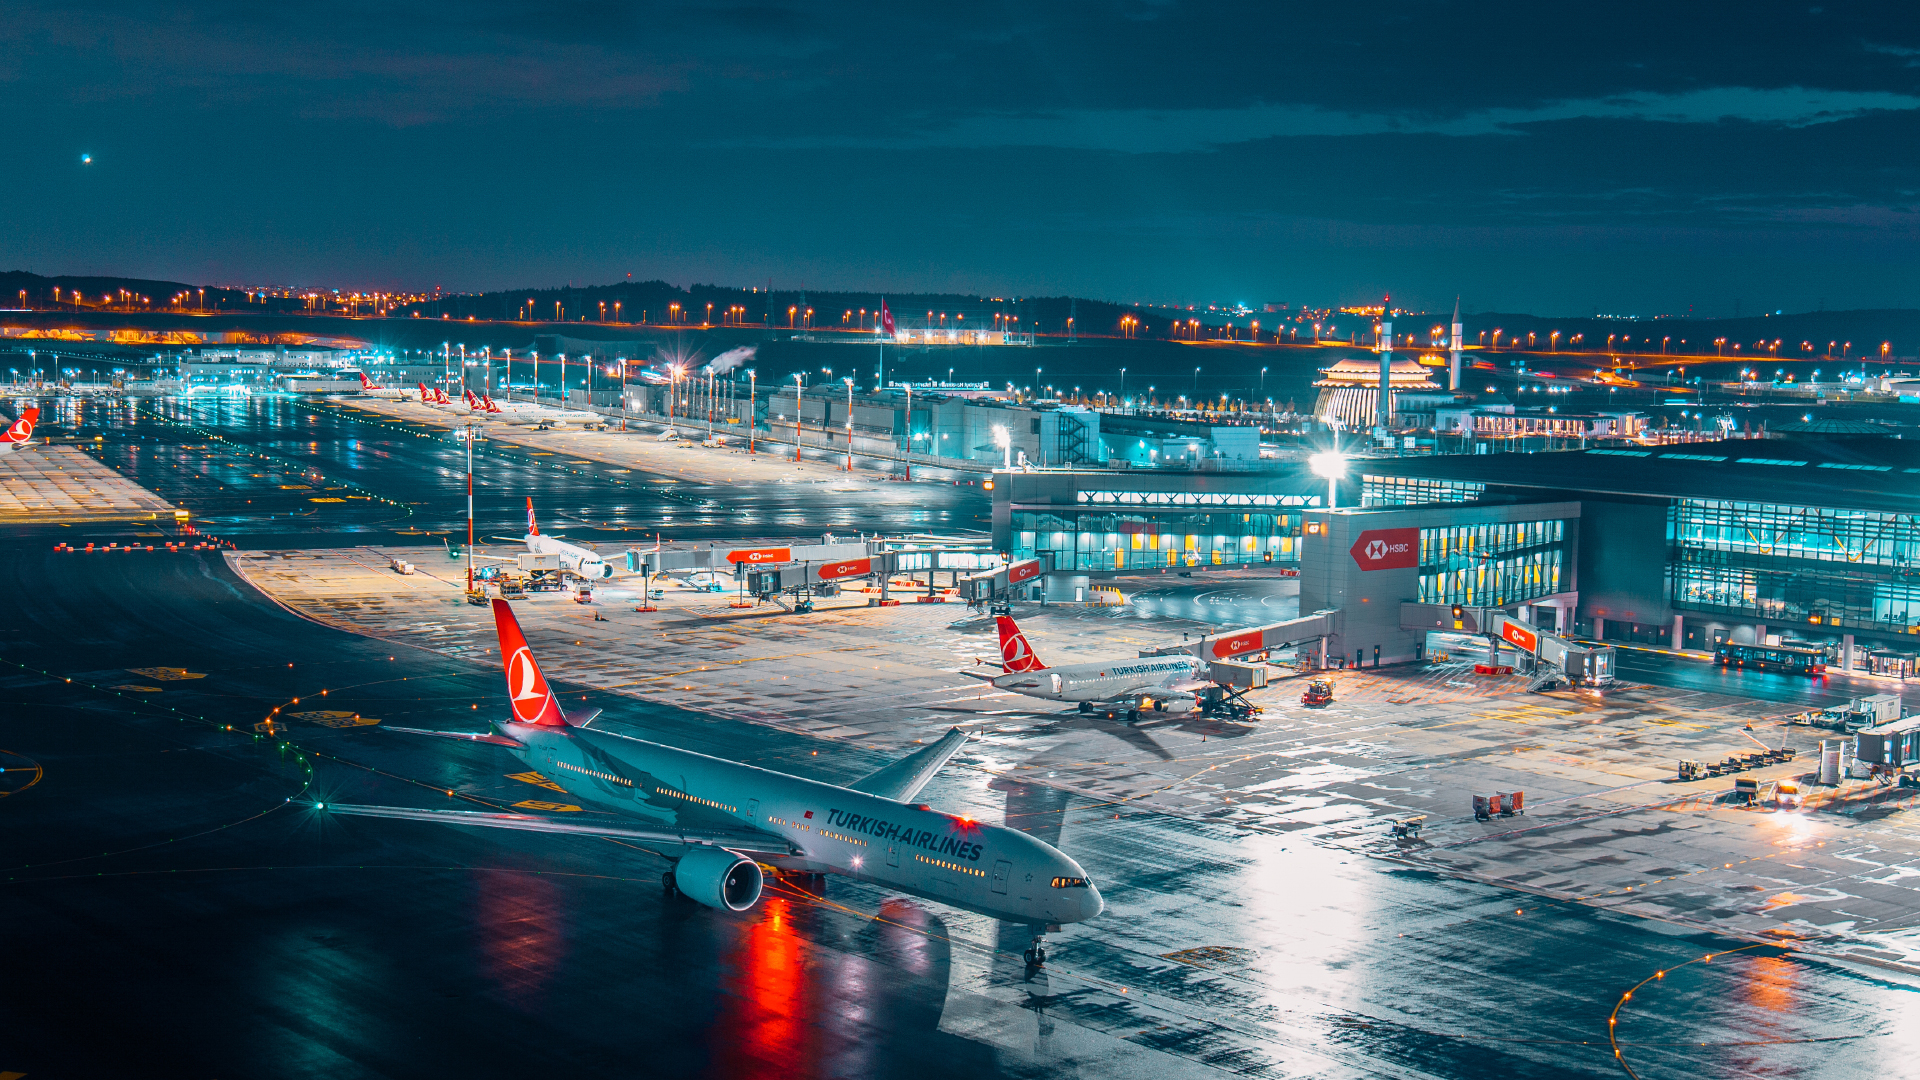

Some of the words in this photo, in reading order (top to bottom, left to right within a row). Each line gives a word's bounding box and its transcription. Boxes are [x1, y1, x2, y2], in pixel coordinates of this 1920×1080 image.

[1389, 543, 1409, 553] HSBC
[1111, 663, 1150, 676] TURKISH
[1151, 660, 1189, 672] AIRLINES
[826, 808, 902, 841] TURKISH
[898, 827, 984, 862] AIRLINES
